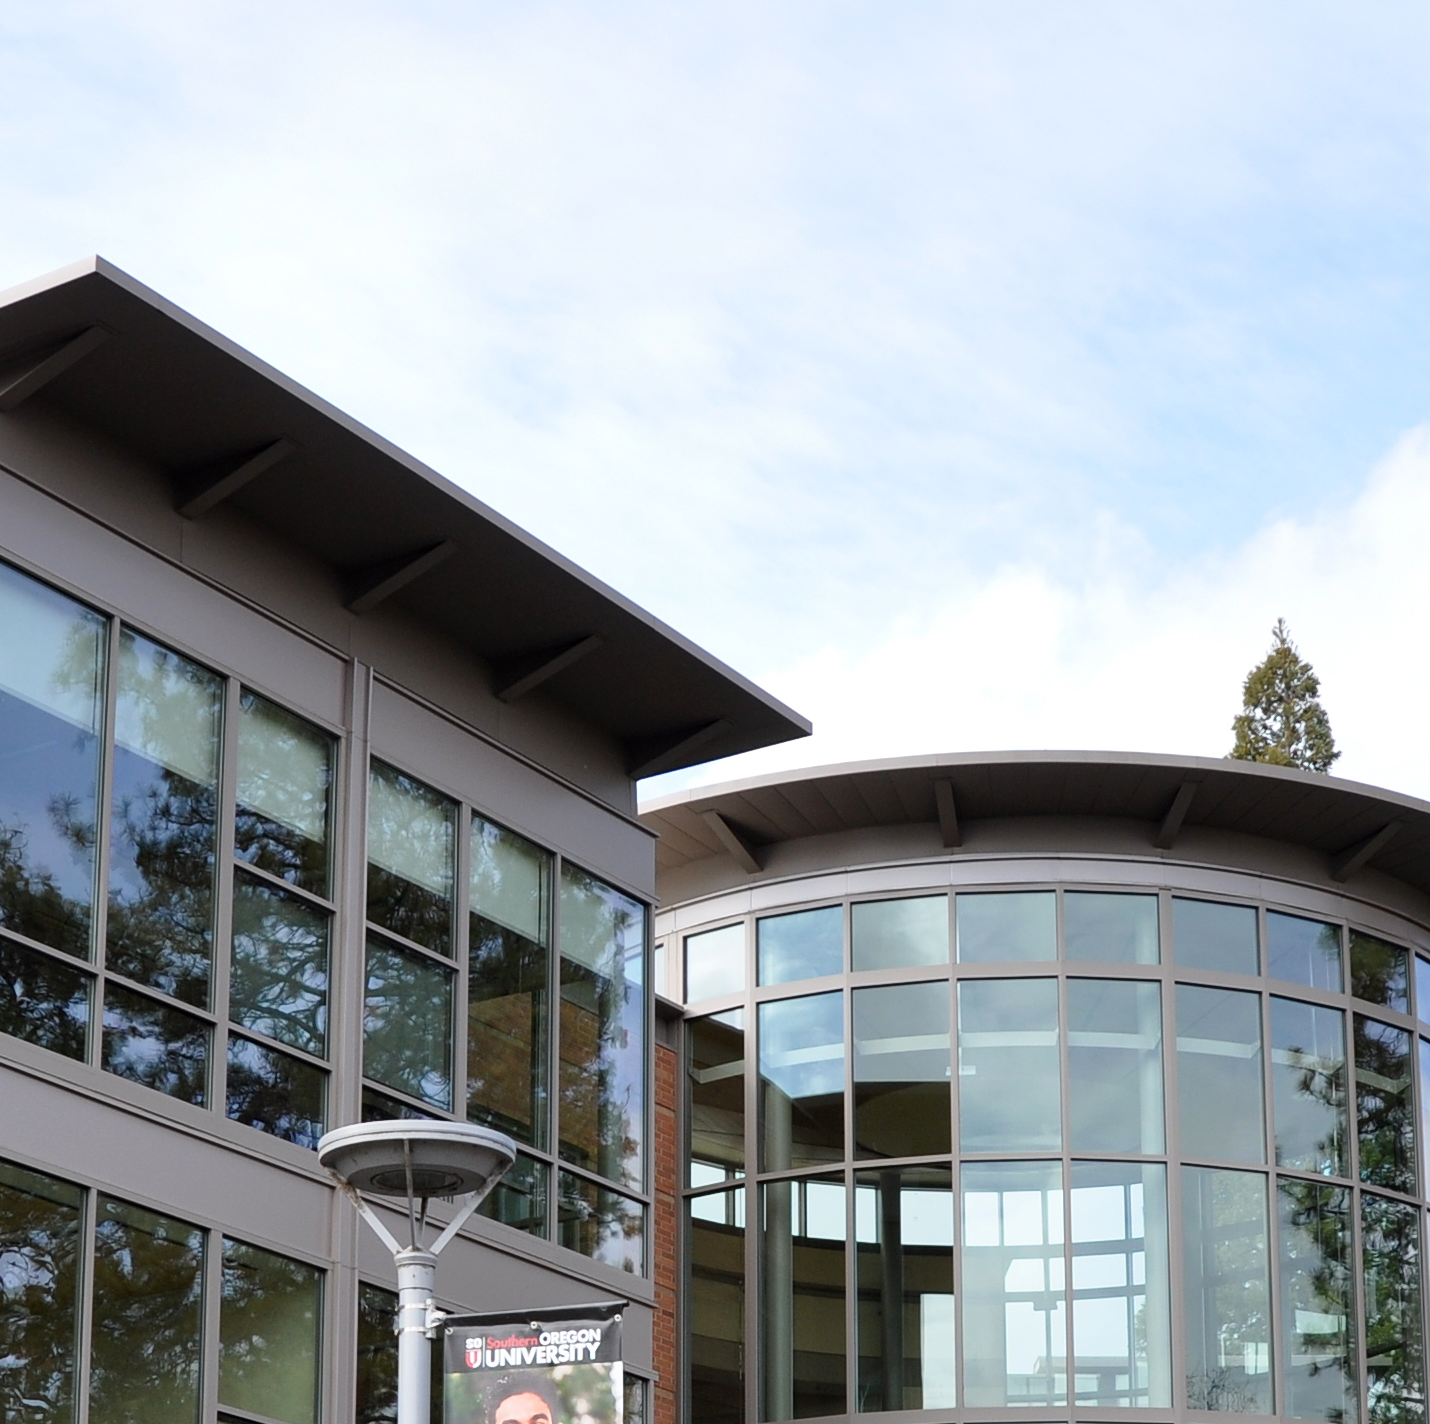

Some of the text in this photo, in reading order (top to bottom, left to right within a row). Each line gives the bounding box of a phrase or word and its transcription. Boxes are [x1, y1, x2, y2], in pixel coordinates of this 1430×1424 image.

[486, 1328, 601, 1349] Southern OREGON
[485, 1342, 601, 1368] UNIVERSITY
